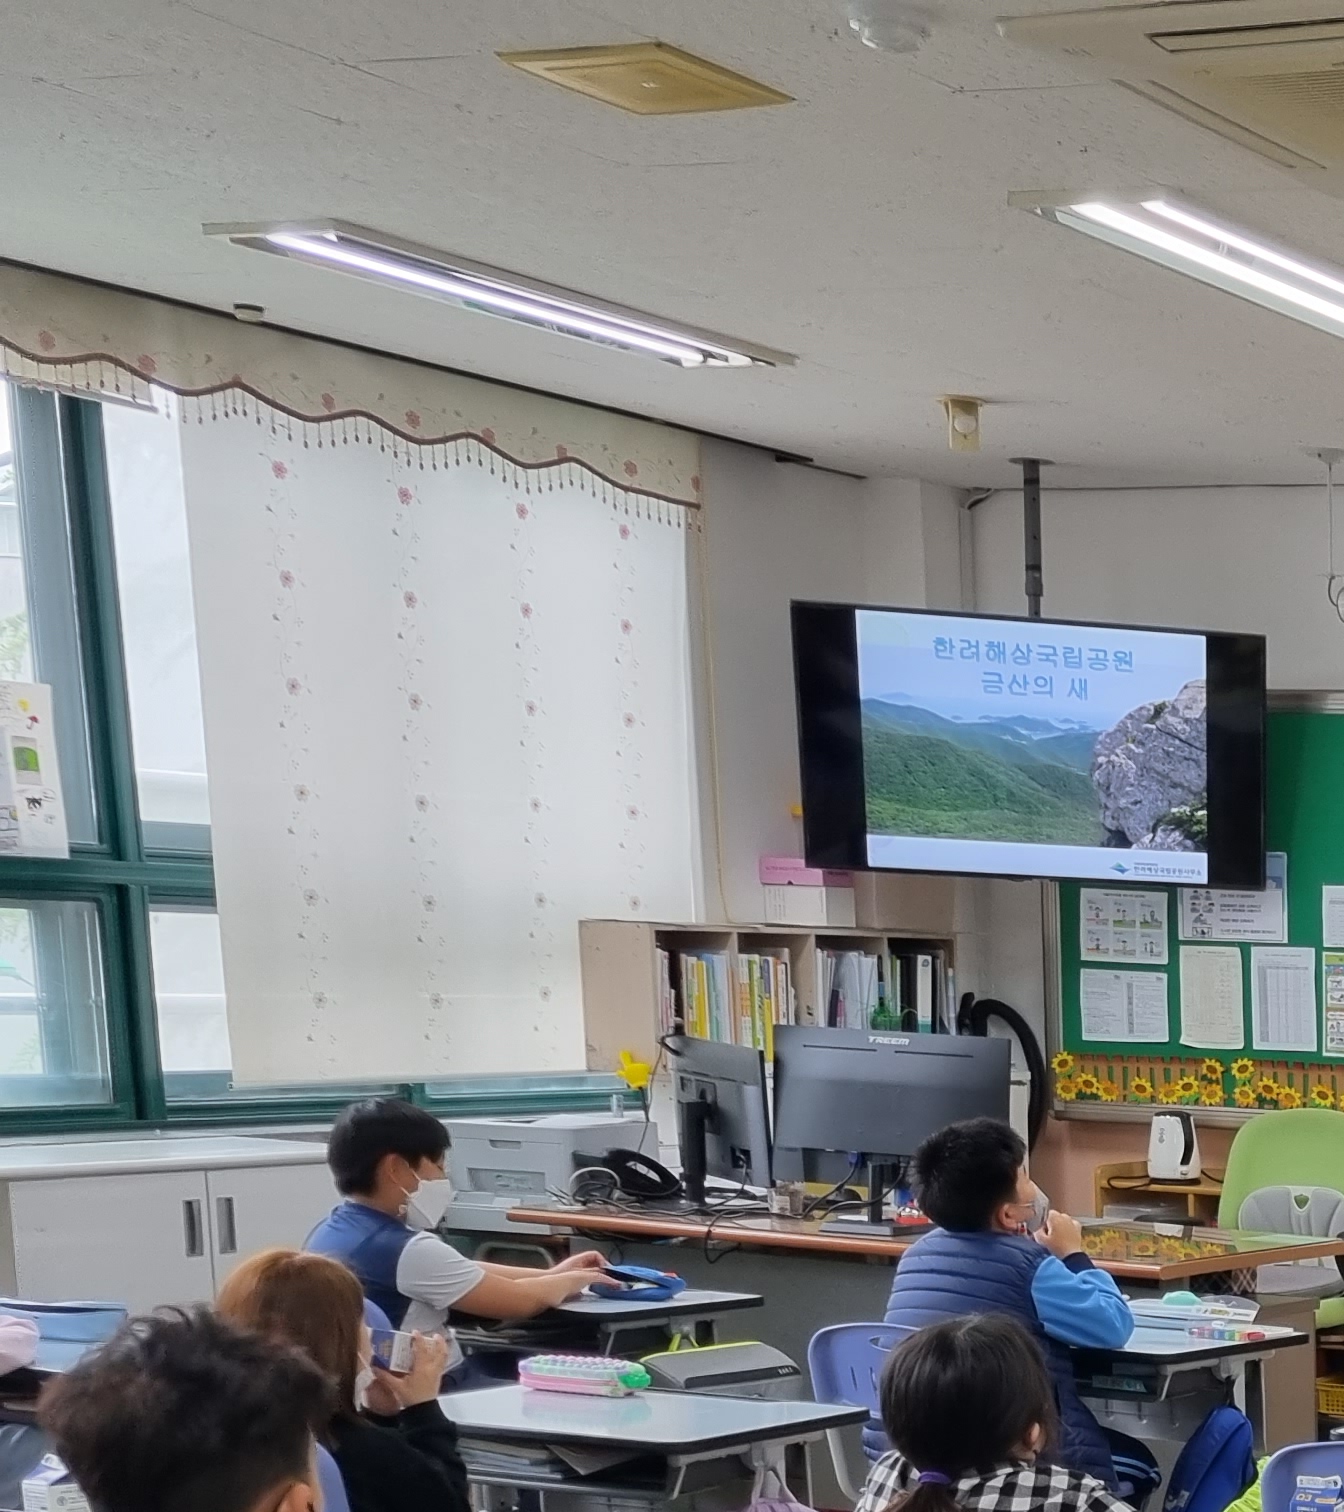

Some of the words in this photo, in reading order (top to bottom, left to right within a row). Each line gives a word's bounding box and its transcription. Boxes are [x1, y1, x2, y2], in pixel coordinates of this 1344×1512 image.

[932, 636, 1134, 673] 한려해상국립공원
[981, 671, 1054, 698] 금산의
[1067, 677, 1088, 701] 새
